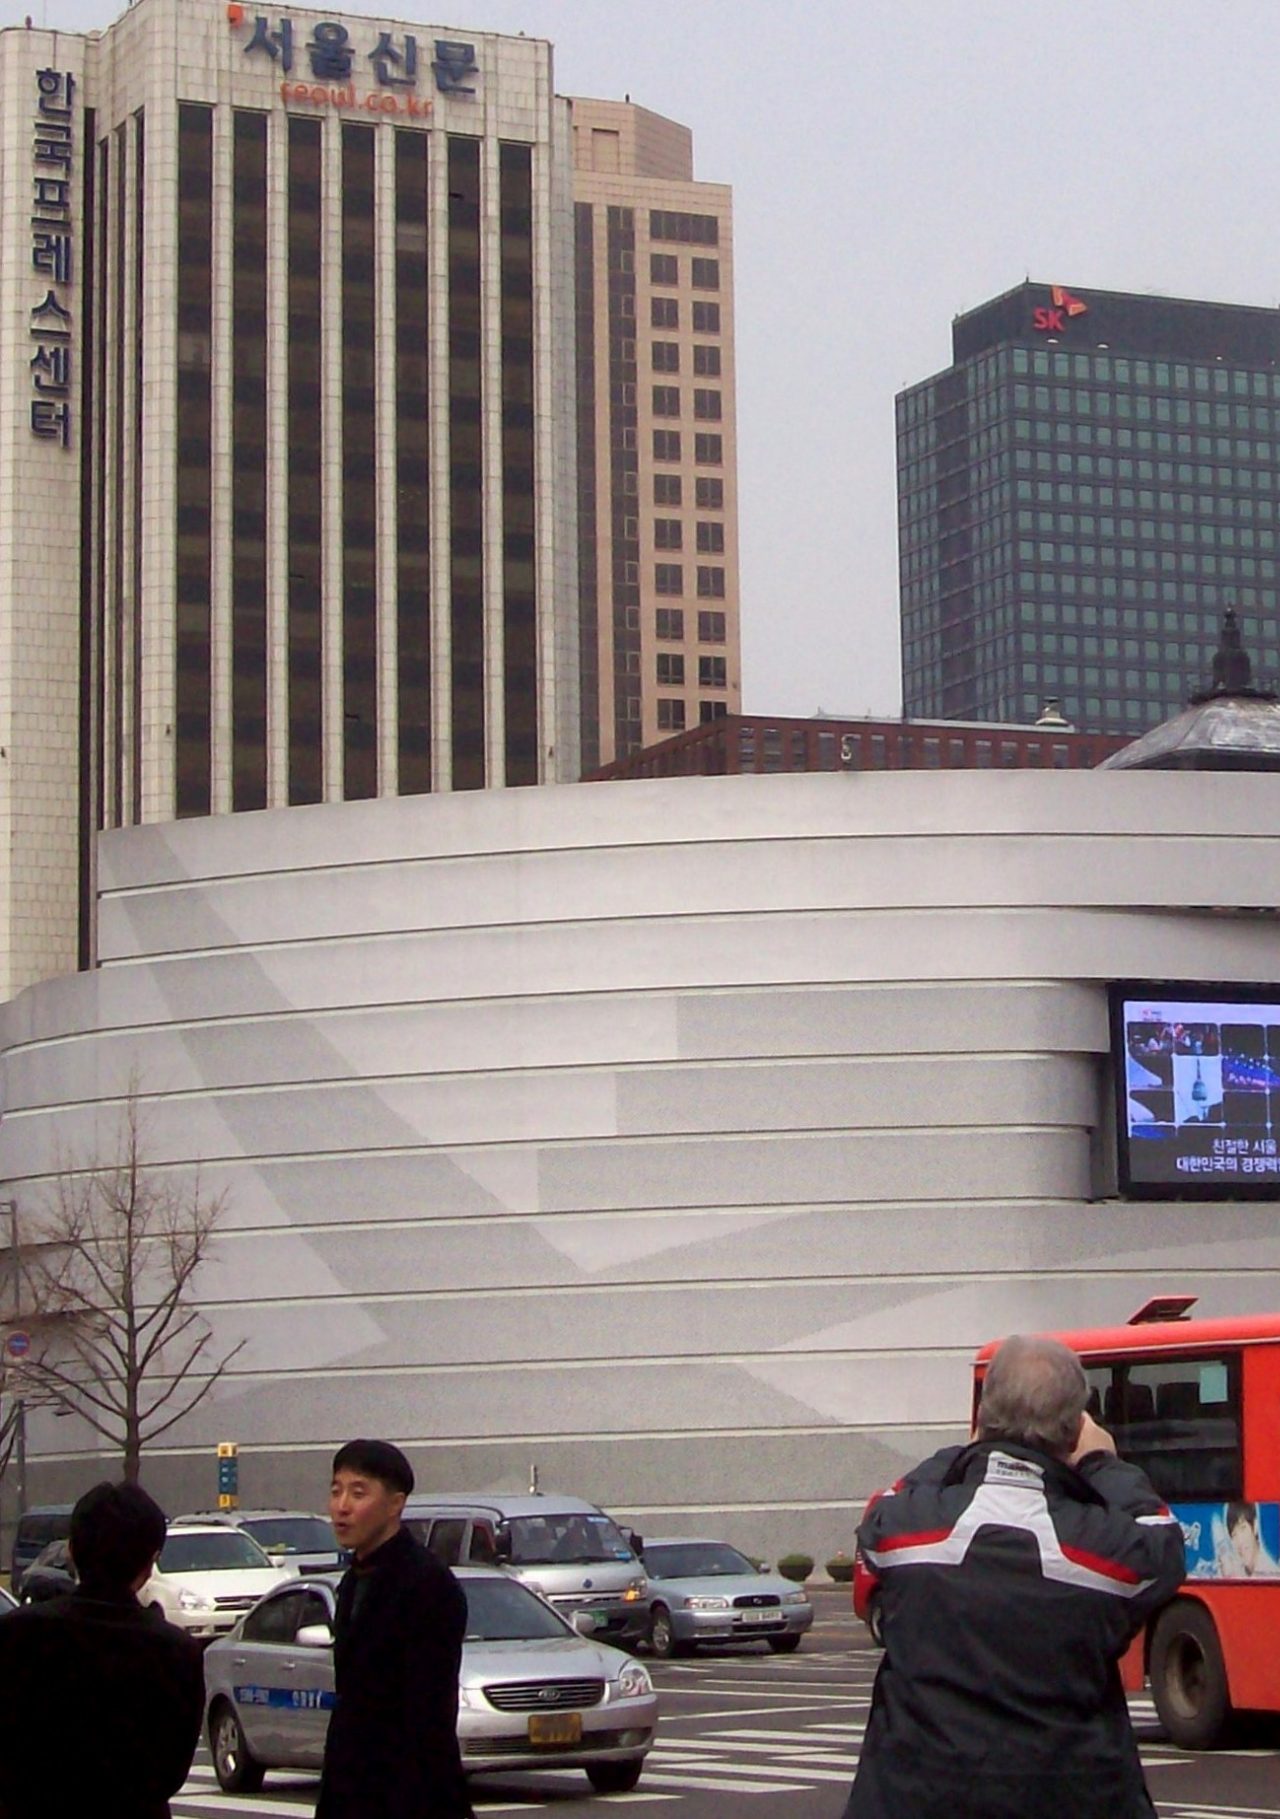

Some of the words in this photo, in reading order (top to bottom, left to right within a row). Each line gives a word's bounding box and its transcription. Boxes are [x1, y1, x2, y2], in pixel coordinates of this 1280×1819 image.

[243, 16, 479, 95] 서울신문
[280, 81, 433, 118] seoul.co.kr
[29, 66, 76, 450] 한국프레스센터
[1033, 306, 1066, 332] SK
